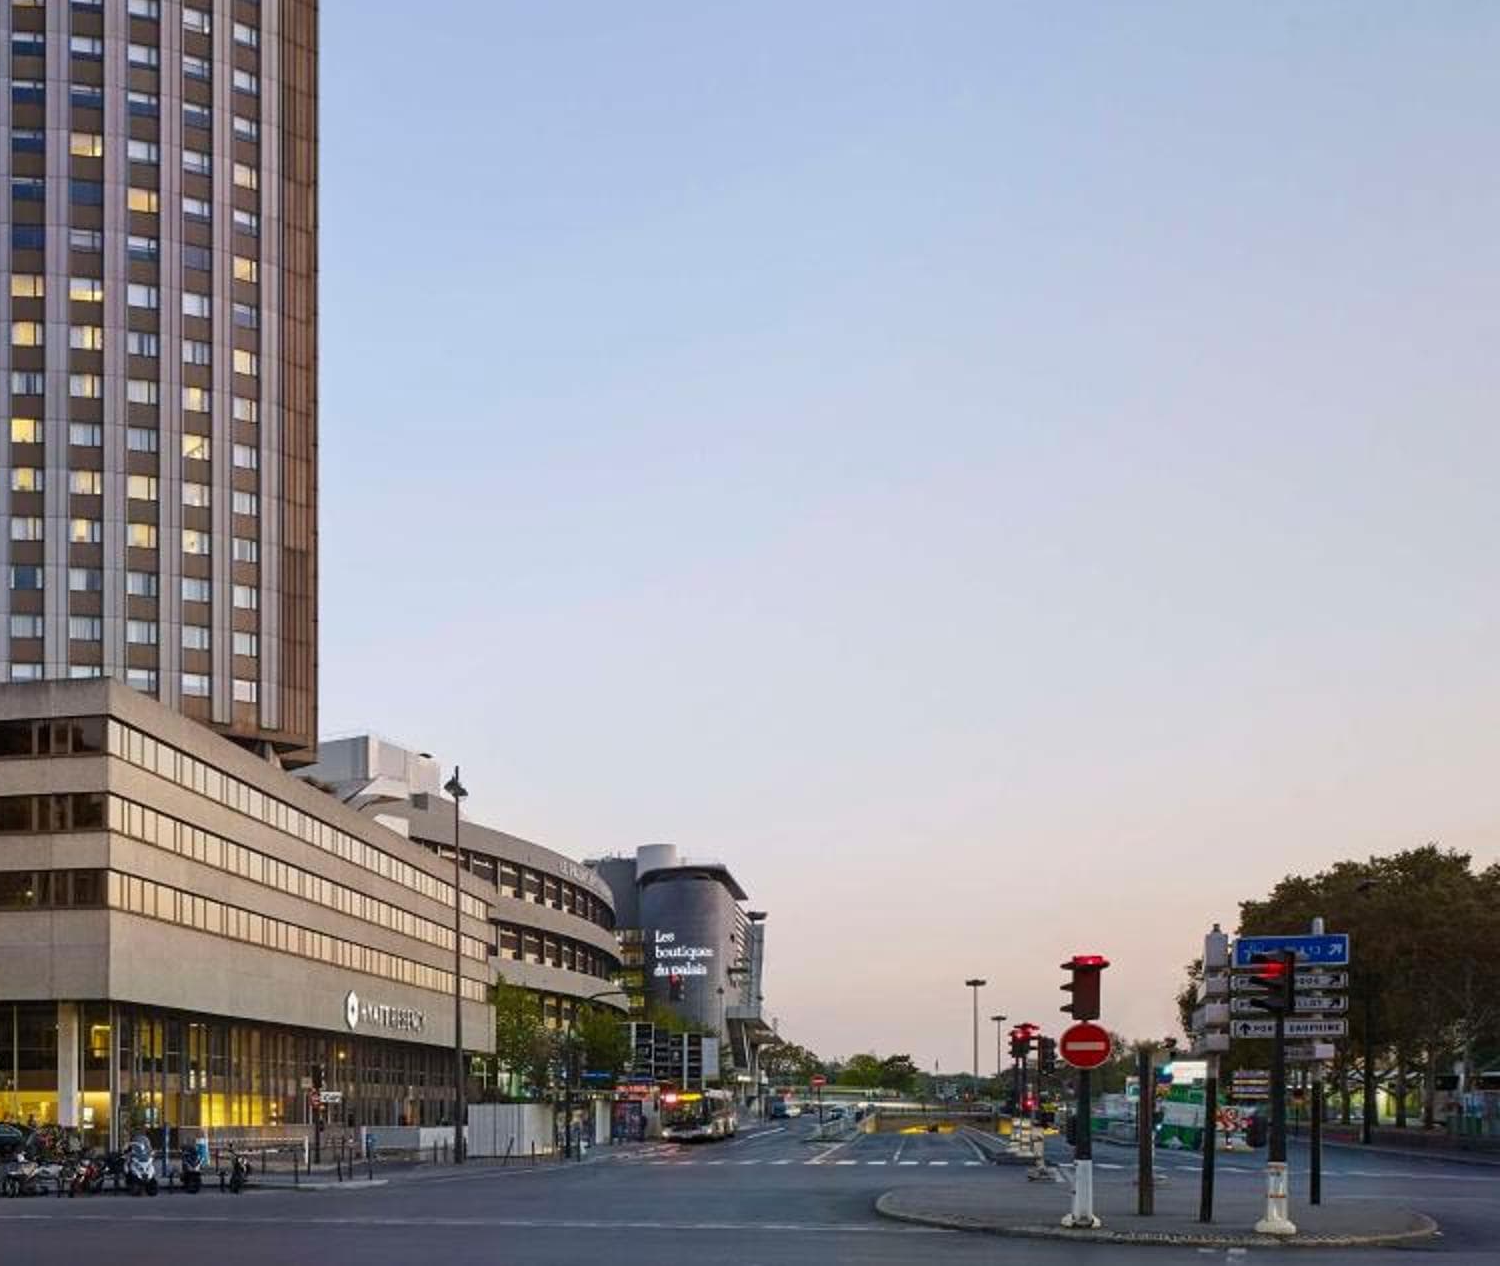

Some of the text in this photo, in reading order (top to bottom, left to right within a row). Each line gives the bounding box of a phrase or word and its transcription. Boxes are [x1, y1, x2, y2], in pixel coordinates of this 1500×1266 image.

[655, 930, 676, 943] Les
[655, 945, 715, 961] boutiques
[654, 961, 708, 976] du palais
